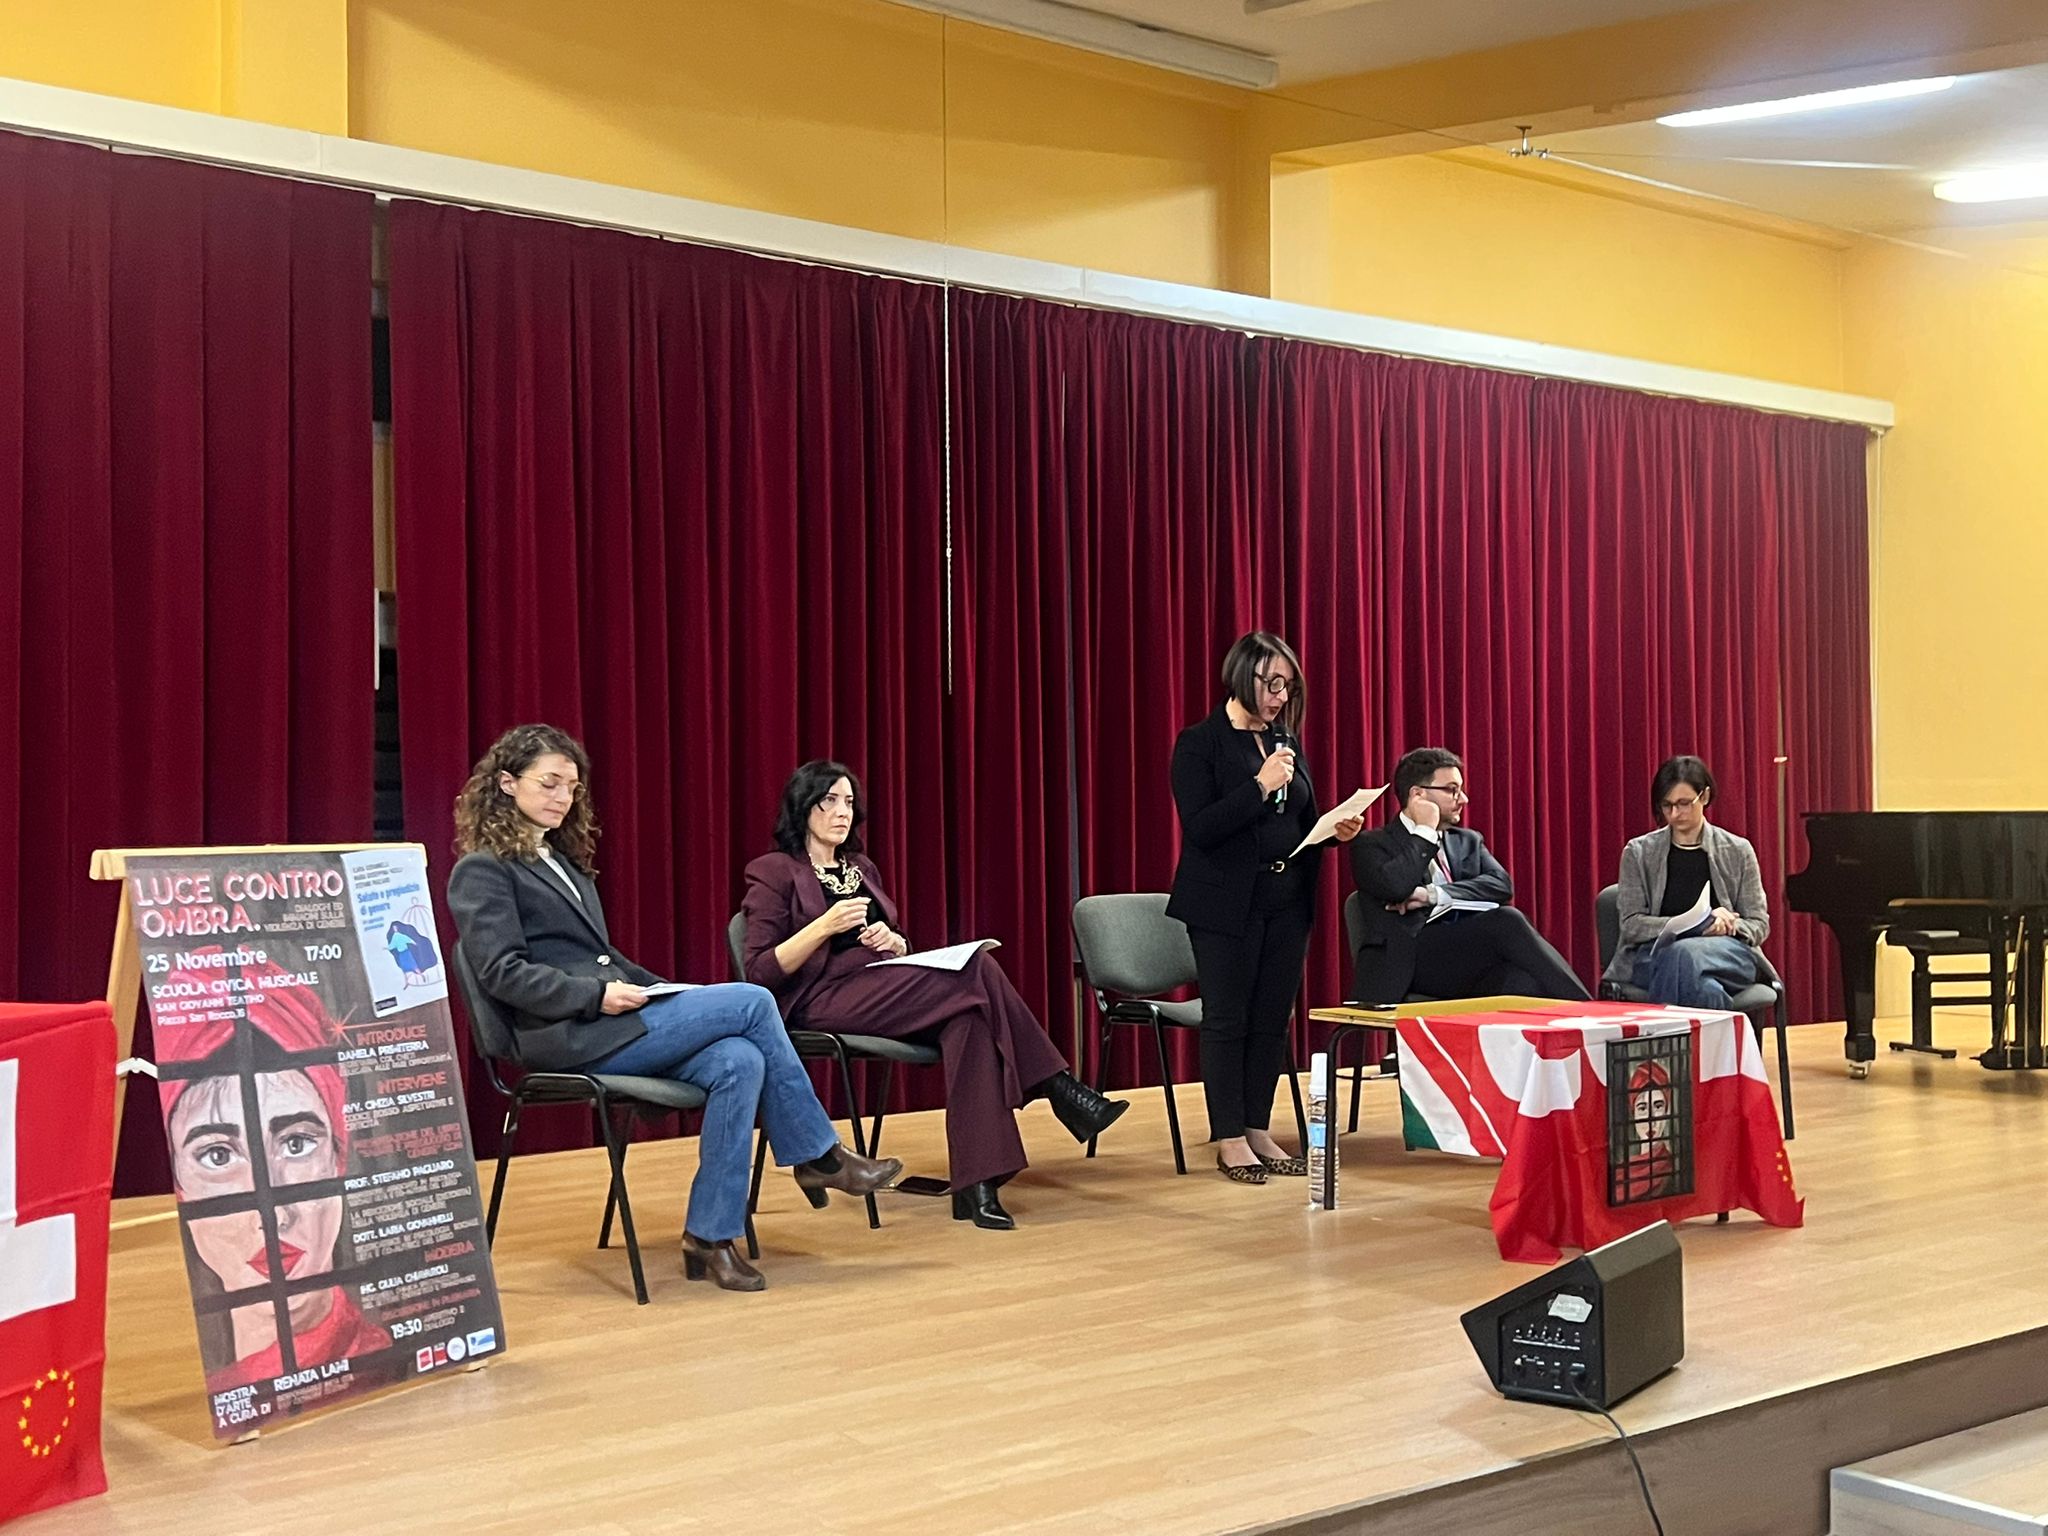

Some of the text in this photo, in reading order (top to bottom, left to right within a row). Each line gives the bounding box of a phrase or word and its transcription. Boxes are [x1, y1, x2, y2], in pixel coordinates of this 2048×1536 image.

[134, 873, 214, 906] LUCE
[224, 868, 344, 901] CONTRO
[140, 903, 261, 938] OMBRA.
[146, 949, 267, 973] 25 Novembre
[304, 944, 342, 962] 17:00
[152, 971, 320, 999] SCUOLA CIVICA MUSICALE
[155, 1002, 177, 1013] SAN
[356, 1024, 428, 1046] INTRODUCE
[377, 1071, 448, 1094] INTERVIENE
[371, 1168, 411, 1185] STEFANO
[390, 1318, 422, 1340] 19:30
[273, 1368, 320, 1391] RENATA
[213, 1384, 258, 1406] MOSTRA
[215, 1397, 252, 1417] D'ARTE
[218, 1402, 272, 1428] A CURA DI
